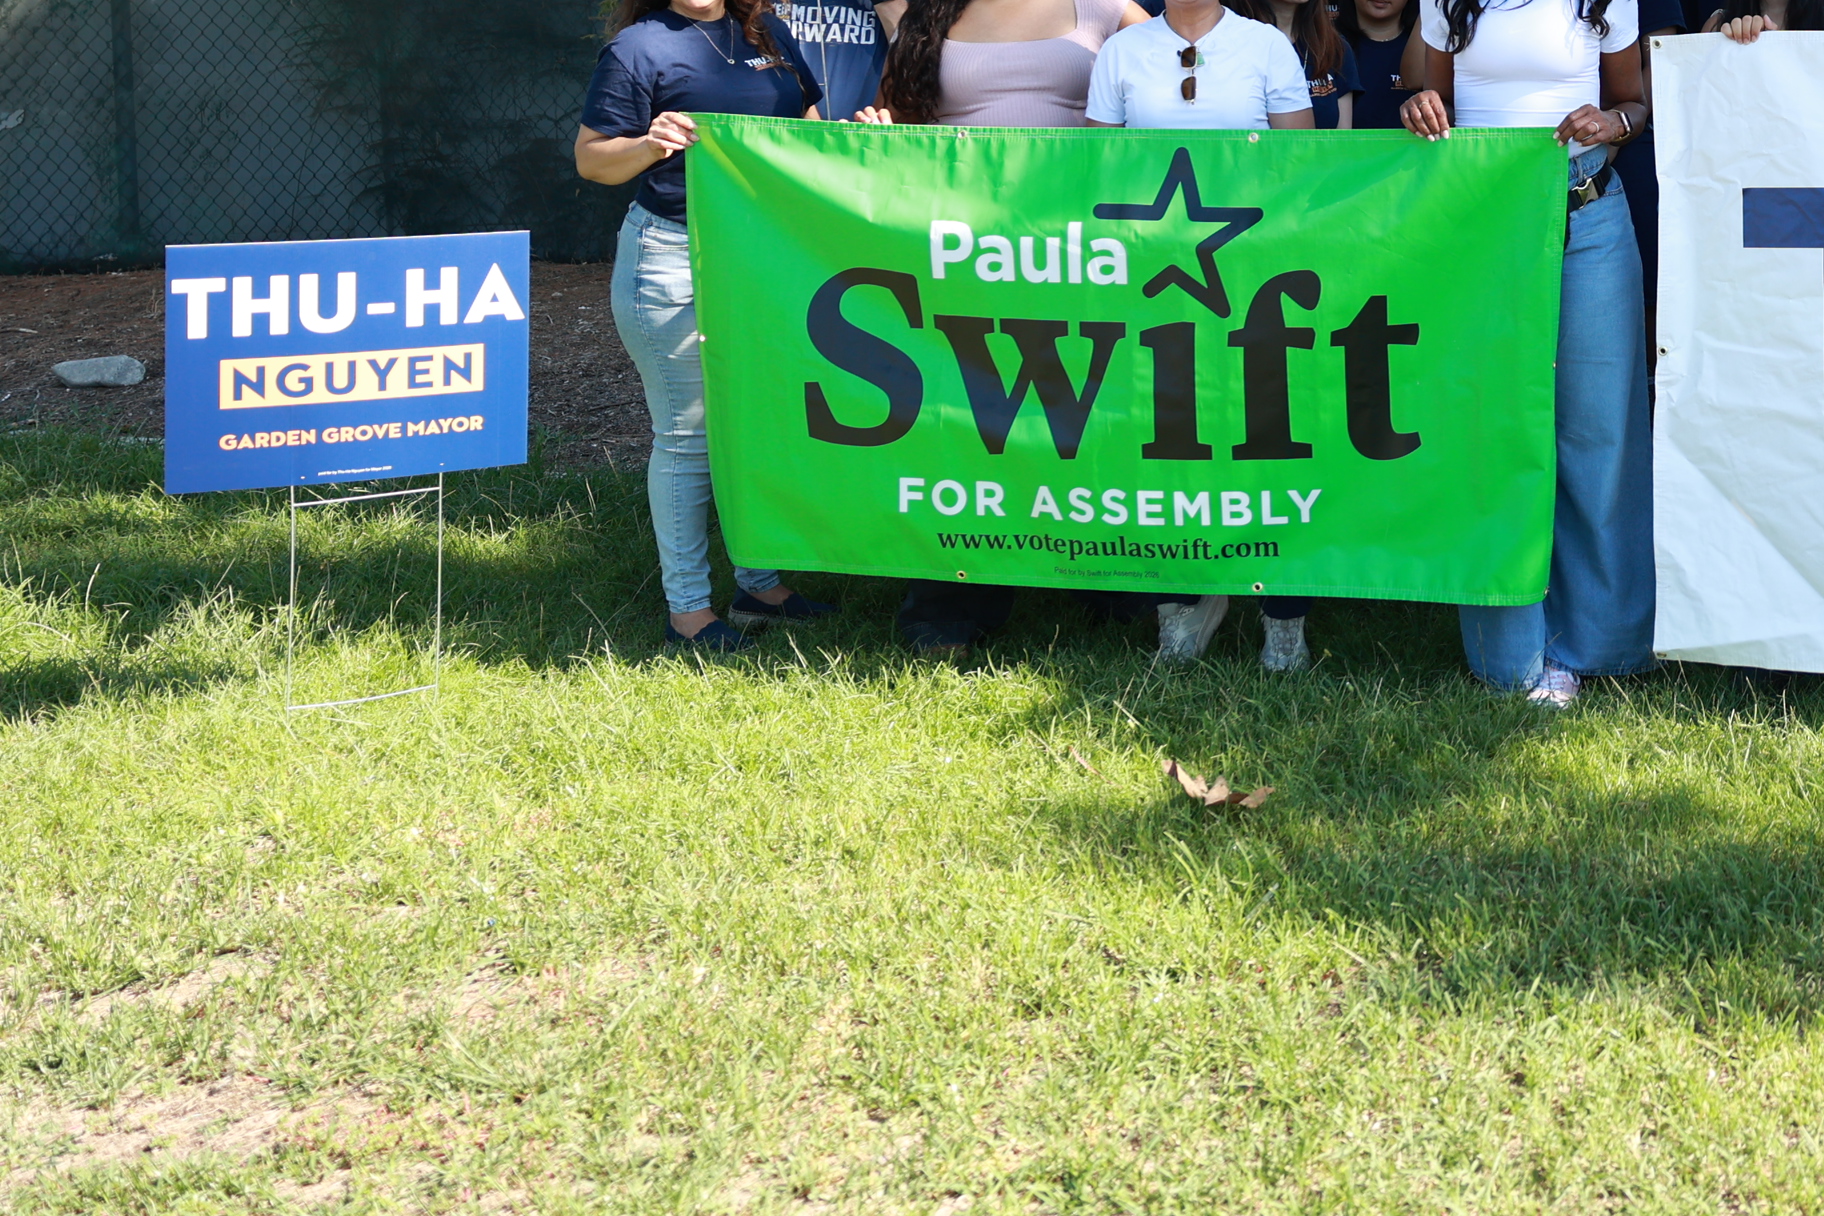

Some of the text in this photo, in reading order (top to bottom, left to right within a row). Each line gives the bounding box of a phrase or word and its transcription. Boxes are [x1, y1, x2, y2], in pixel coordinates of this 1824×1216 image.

[791, 5, 876, 27] MOVING
[929, 219, 1129, 287] Paula
[171, 262, 526, 340] THU-HA
[232, 351, 472, 401] NGUYEN
[804, 267, 1422, 461] Swift
[219, 415, 484, 451] GARDEN GROVE MAYOR
[897, 477, 1322, 527] FOR ASSEMBLY
[937, 531, 1280, 561] www.votepaulaswift.com
[1054, 566, 1067, 575] Paid
[1078, 569, 1085, 577] by
[1087, 569, 1102, 577] Swift
[1113, 570, 1143, 579] Assembly
